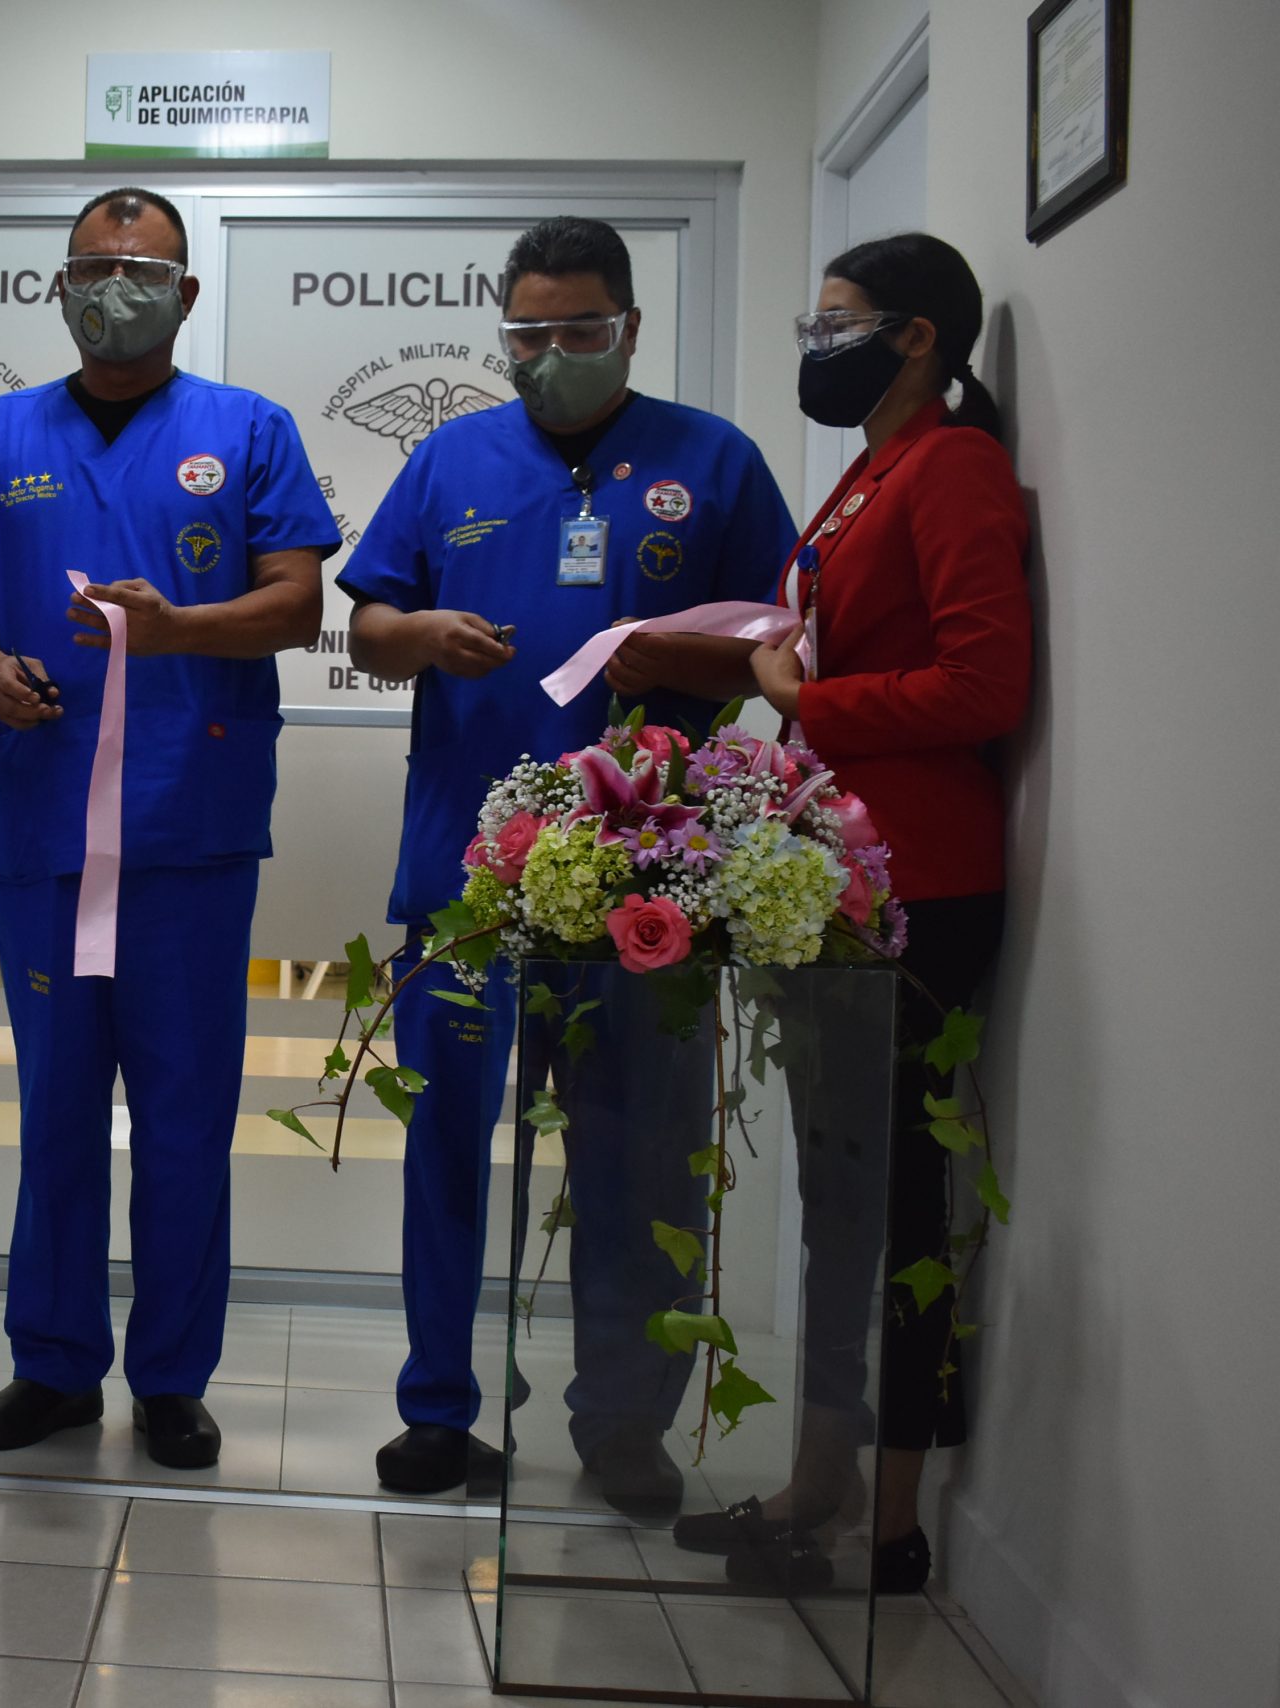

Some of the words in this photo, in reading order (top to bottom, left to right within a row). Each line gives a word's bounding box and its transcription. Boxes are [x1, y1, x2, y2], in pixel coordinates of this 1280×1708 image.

[138, 81, 245, 102] APLICACIÓN
[138, 108, 160, 124] DE
[167, 107, 310, 126] QUIMIOTERAPIA
[292, 263, 504, 307] POLICLÍN
[321, 356, 393, 420] HOSPITAL
[399, 343, 470, 362] MILITAR
[328, 666, 360, 690] DE
